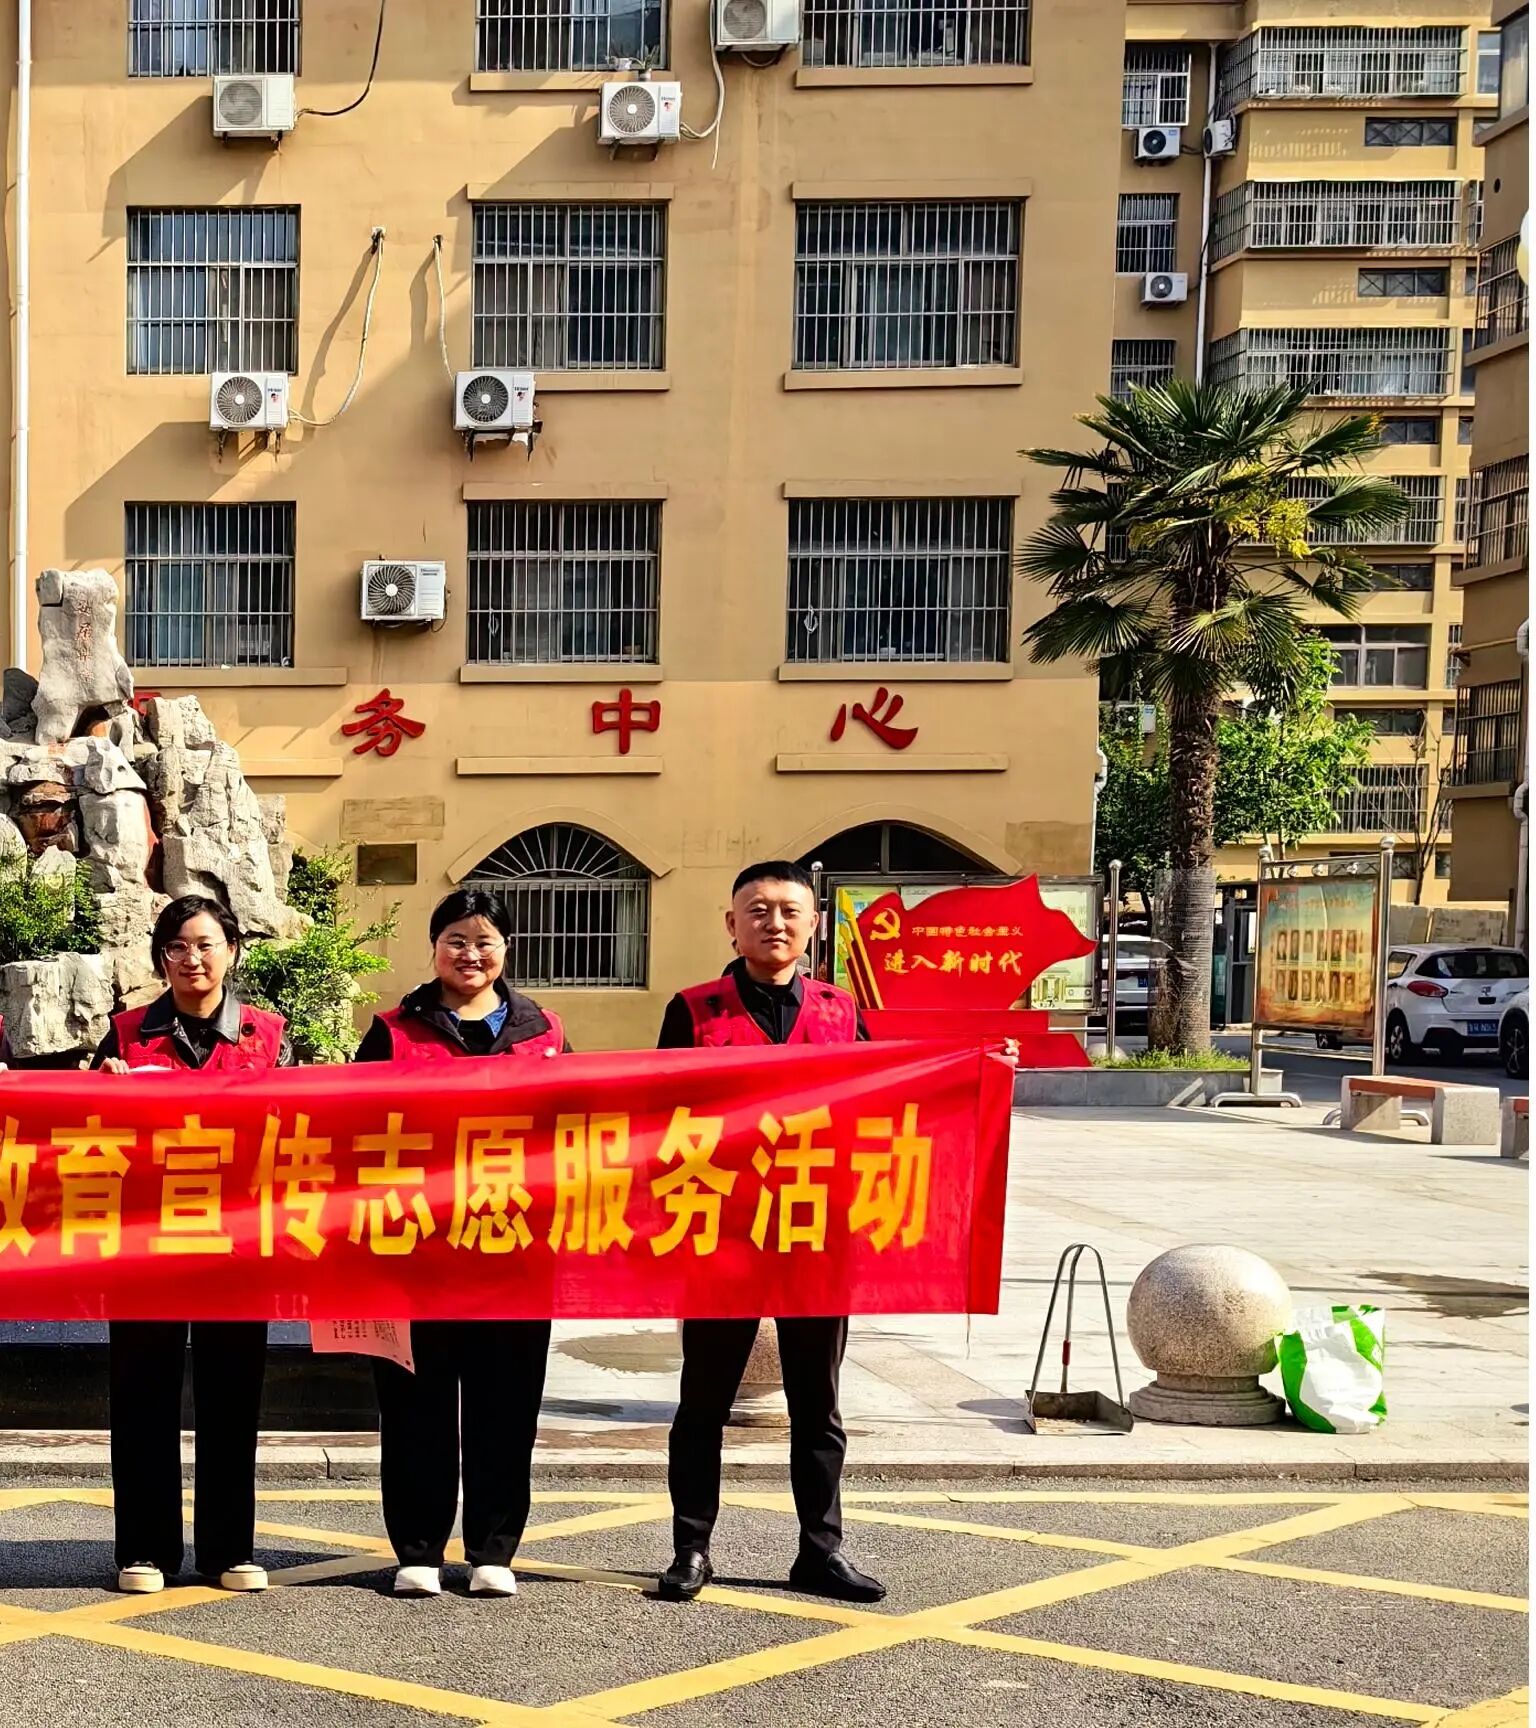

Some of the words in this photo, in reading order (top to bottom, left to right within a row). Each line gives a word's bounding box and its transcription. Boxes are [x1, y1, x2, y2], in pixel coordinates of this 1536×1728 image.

[883, 948, 1024, 977] 进入新时代
